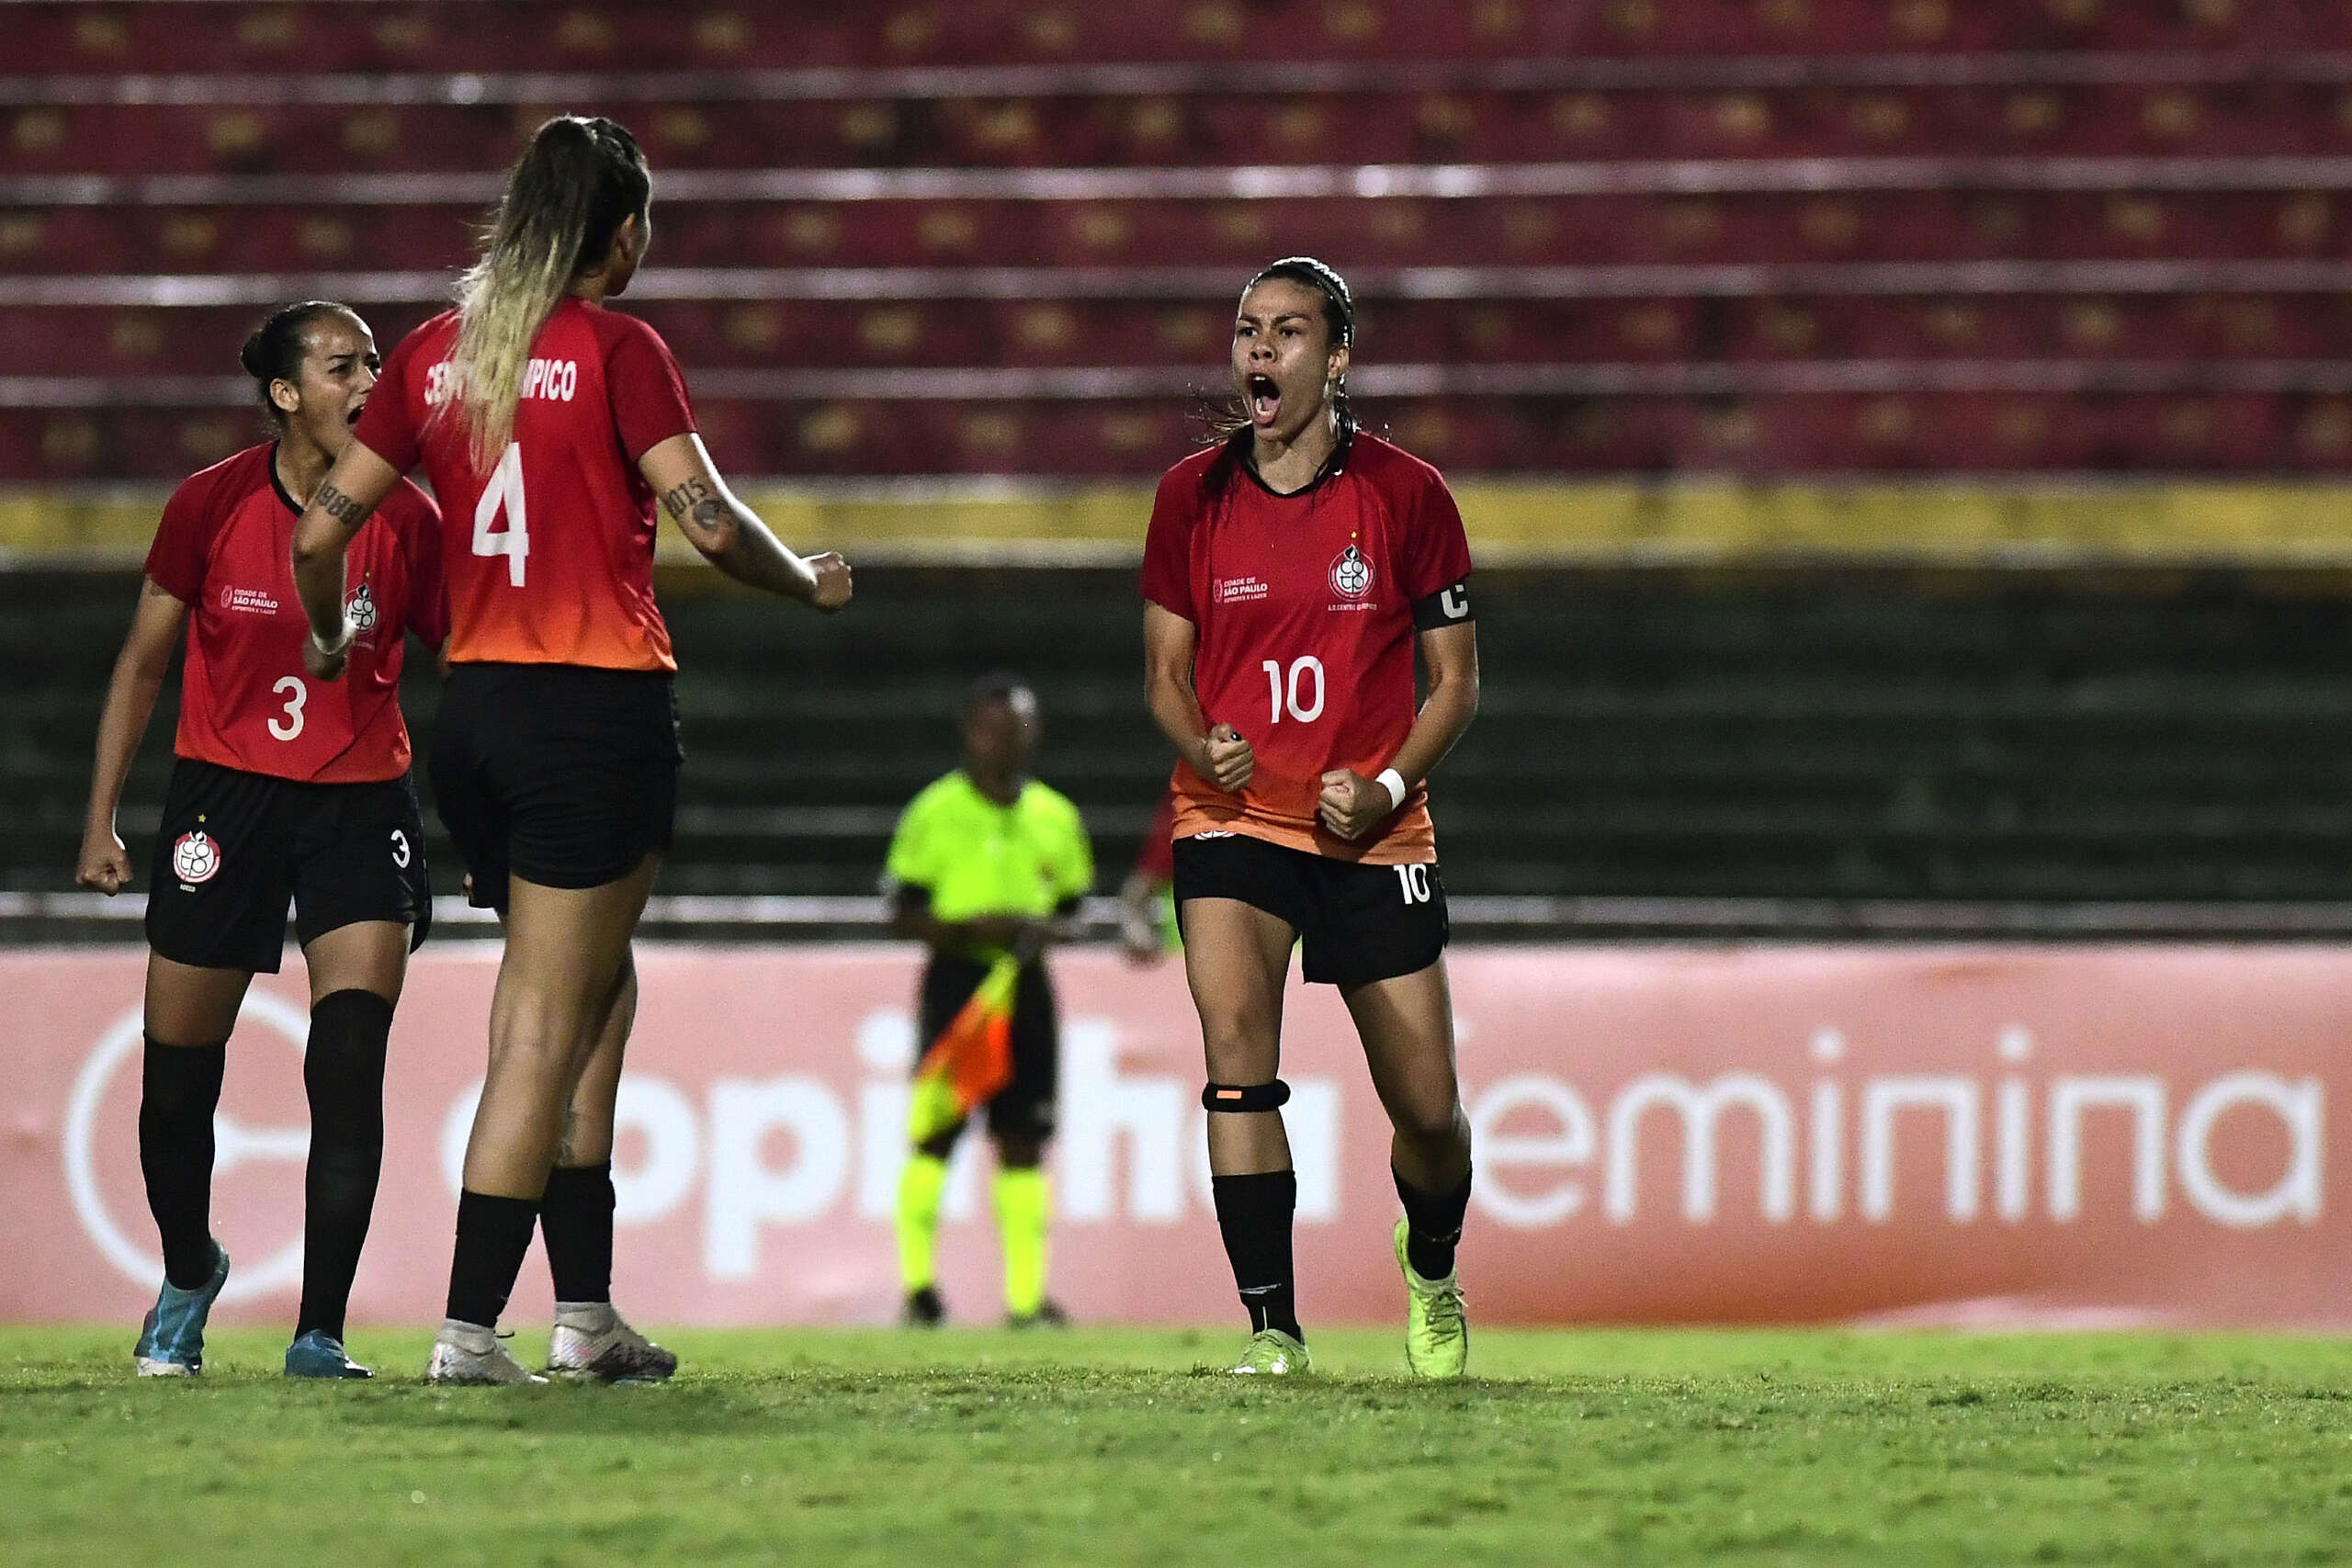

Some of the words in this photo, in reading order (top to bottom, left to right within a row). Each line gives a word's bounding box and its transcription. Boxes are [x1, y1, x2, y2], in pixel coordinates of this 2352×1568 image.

[472, 442, 529, 587] 4
[232, 596, 249, 605] SÃO
[250, 598, 278, 609] PAULO
[257, 591, 267, 599] DE
[1224, 578, 1245, 588] CIDADE
[1224, 586, 1239, 596] SÃO
[1239, 583, 1268, 594] PAULO
[1441, 584, 1468, 618] C
[267, 675, 307, 741] 3
[1262, 655, 1325, 724] 10
[390, 829, 411, 868] 3
[1393, 863, 1430, 905] 10
[1461, 1021, 2325, 1225] eminina
